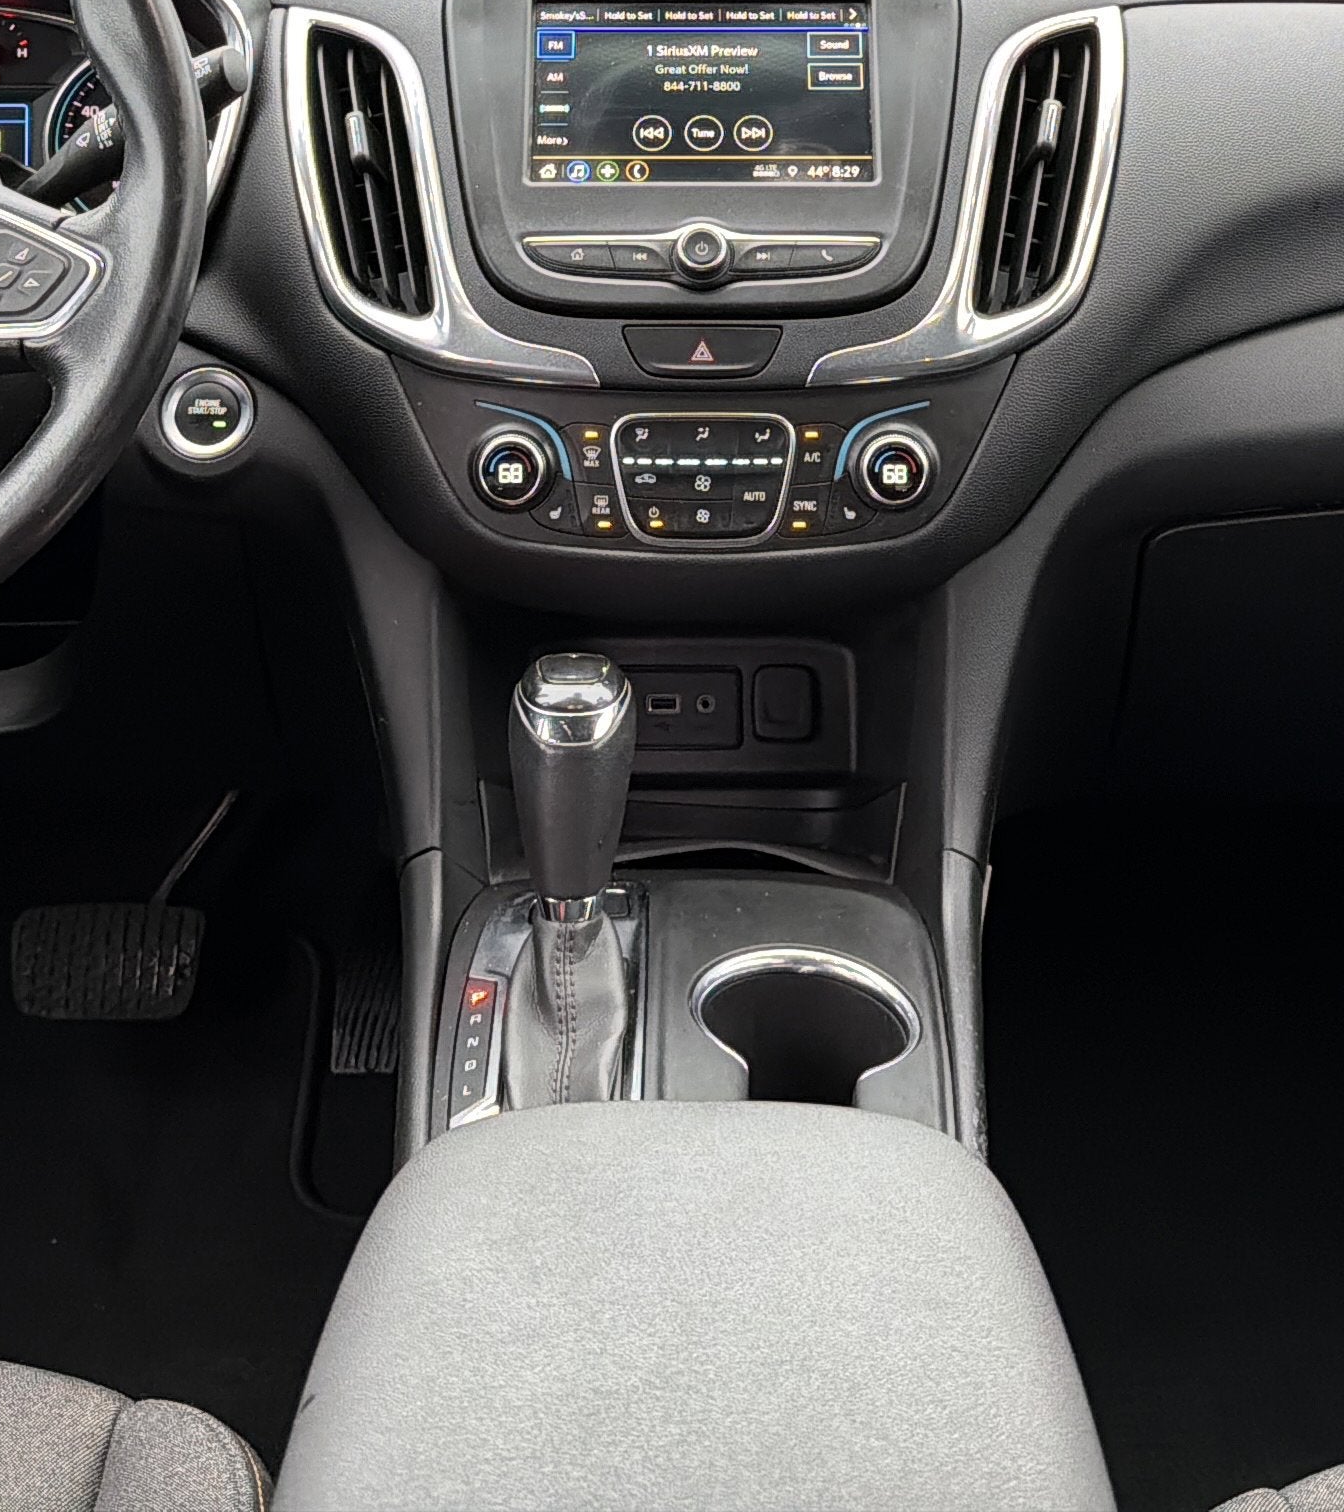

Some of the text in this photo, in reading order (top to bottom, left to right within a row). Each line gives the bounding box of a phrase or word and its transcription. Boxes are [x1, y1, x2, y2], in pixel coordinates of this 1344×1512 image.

[604, 10, 653, 21] Hold to Set
[665, 10, 714, 21] Hold to Set
[726, 10, 775, 21] Hold to Set
[787, 10, 836, 21] Hold to Set
[547, 40, 564, 51] FM
[820, 40, 850, 50] Sound
[16, 48, 28, 58] H
[646, 45, 759, 57] 1 SiriusXM Preview
[655, 63, 749, 75] Great Offer Now!
[546, 72, 564, 82] AM
[818, 71, 853, 81] Browse
[663, 81, 741, 92] 844-711-8800
[81, 105, 99, 118] 40
[691, 128, 715, 138] Tune
[537, 135, 562, 146] More
[807, 165, 860, 178] 44° 8:29
[194, 398, 221, 407] ENGINE
[187, 407, 228, 415] START/STOP
[804, 452, 821, 462] A/C
[498, 462, 523, 483] 68
[882, 464, 907, 484] 68
[743, 491, 766, 501] AUTO
[793, 501, 817, 511] SYNC
[470, 990, 488, 1006] P
[466, 1036, 480, 1048] N
[464, 1059, 477, 1072] D
[462, 1085, 472, 1096] L
